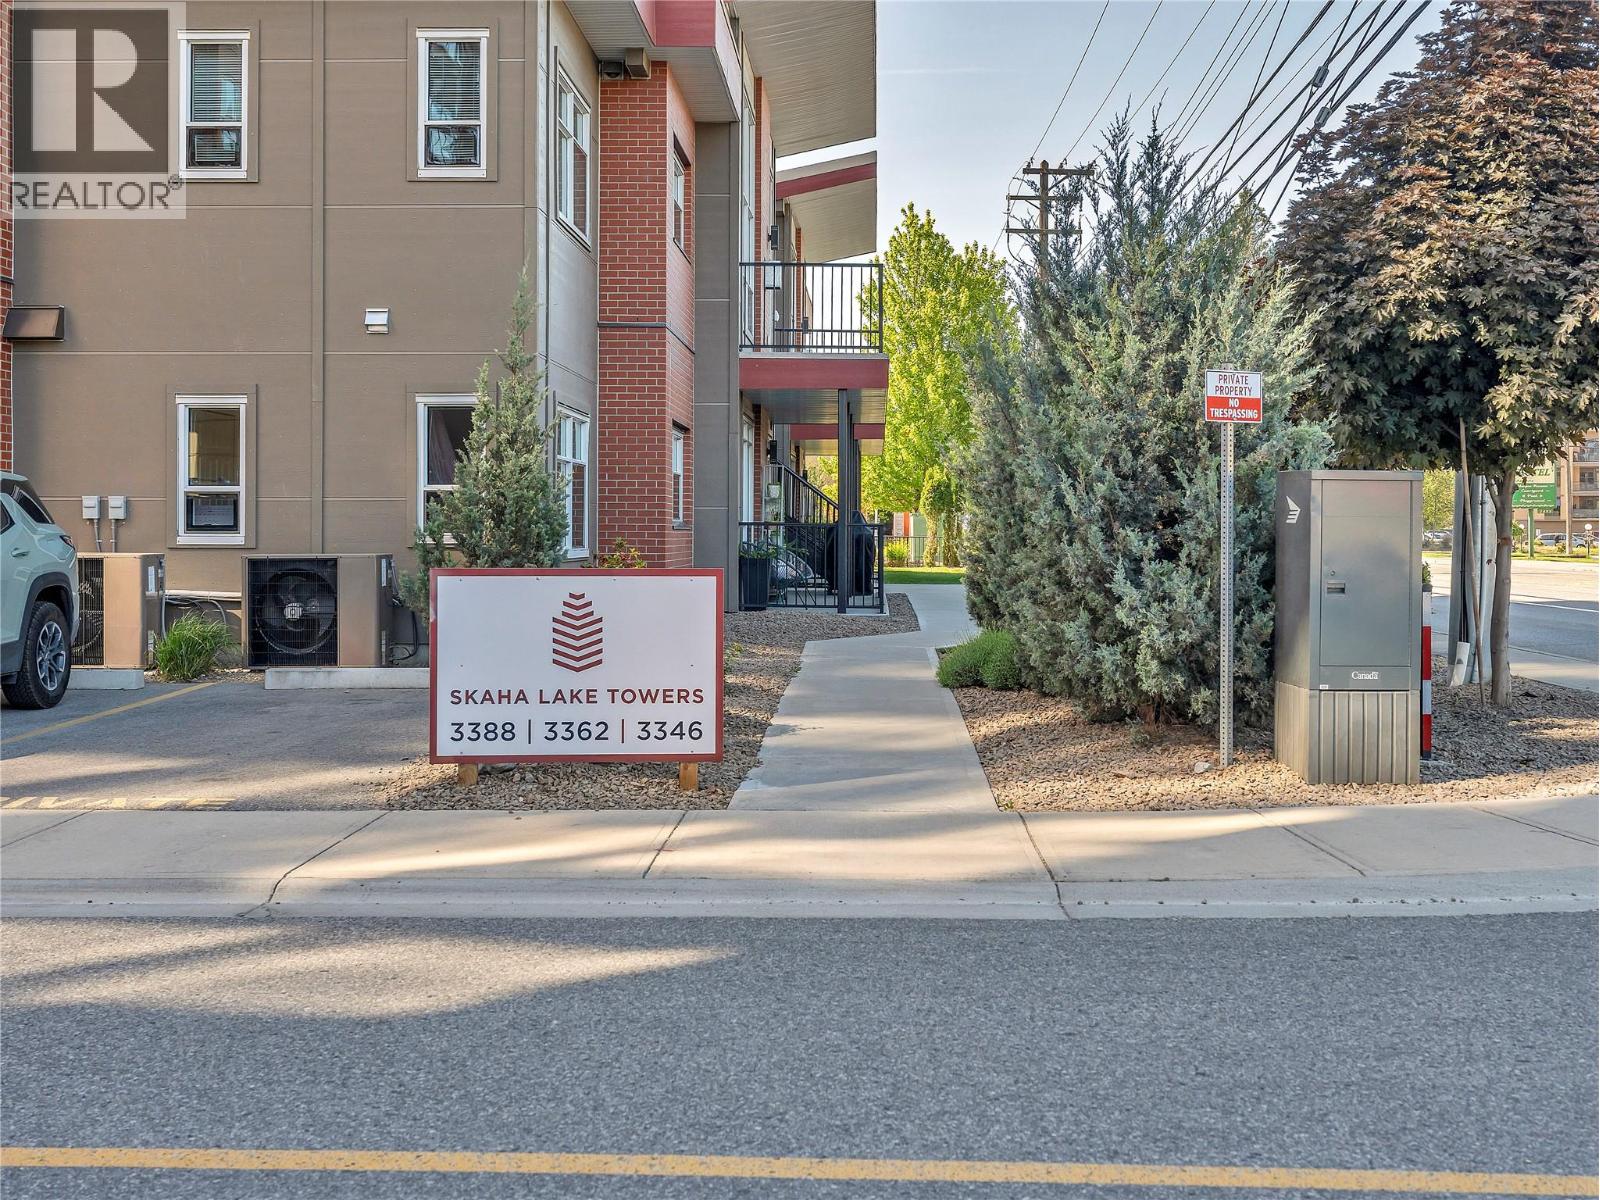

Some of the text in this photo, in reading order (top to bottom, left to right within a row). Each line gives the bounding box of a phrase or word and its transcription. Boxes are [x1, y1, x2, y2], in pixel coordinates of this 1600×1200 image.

[1219, 374, 1249, 385] PRIVATE
[1215, 385, 1252, 396] PROPERTY
[1229, 398, 1239, 408] NO
[1210, 408, 1258, 418] TRESPASSING
[1351, 671, 1378, 679] Canada
[450, 688, 704, 705] SKAHA LAKE TOWERS
[450, 721, 703, 742] 3388 3362 3346
